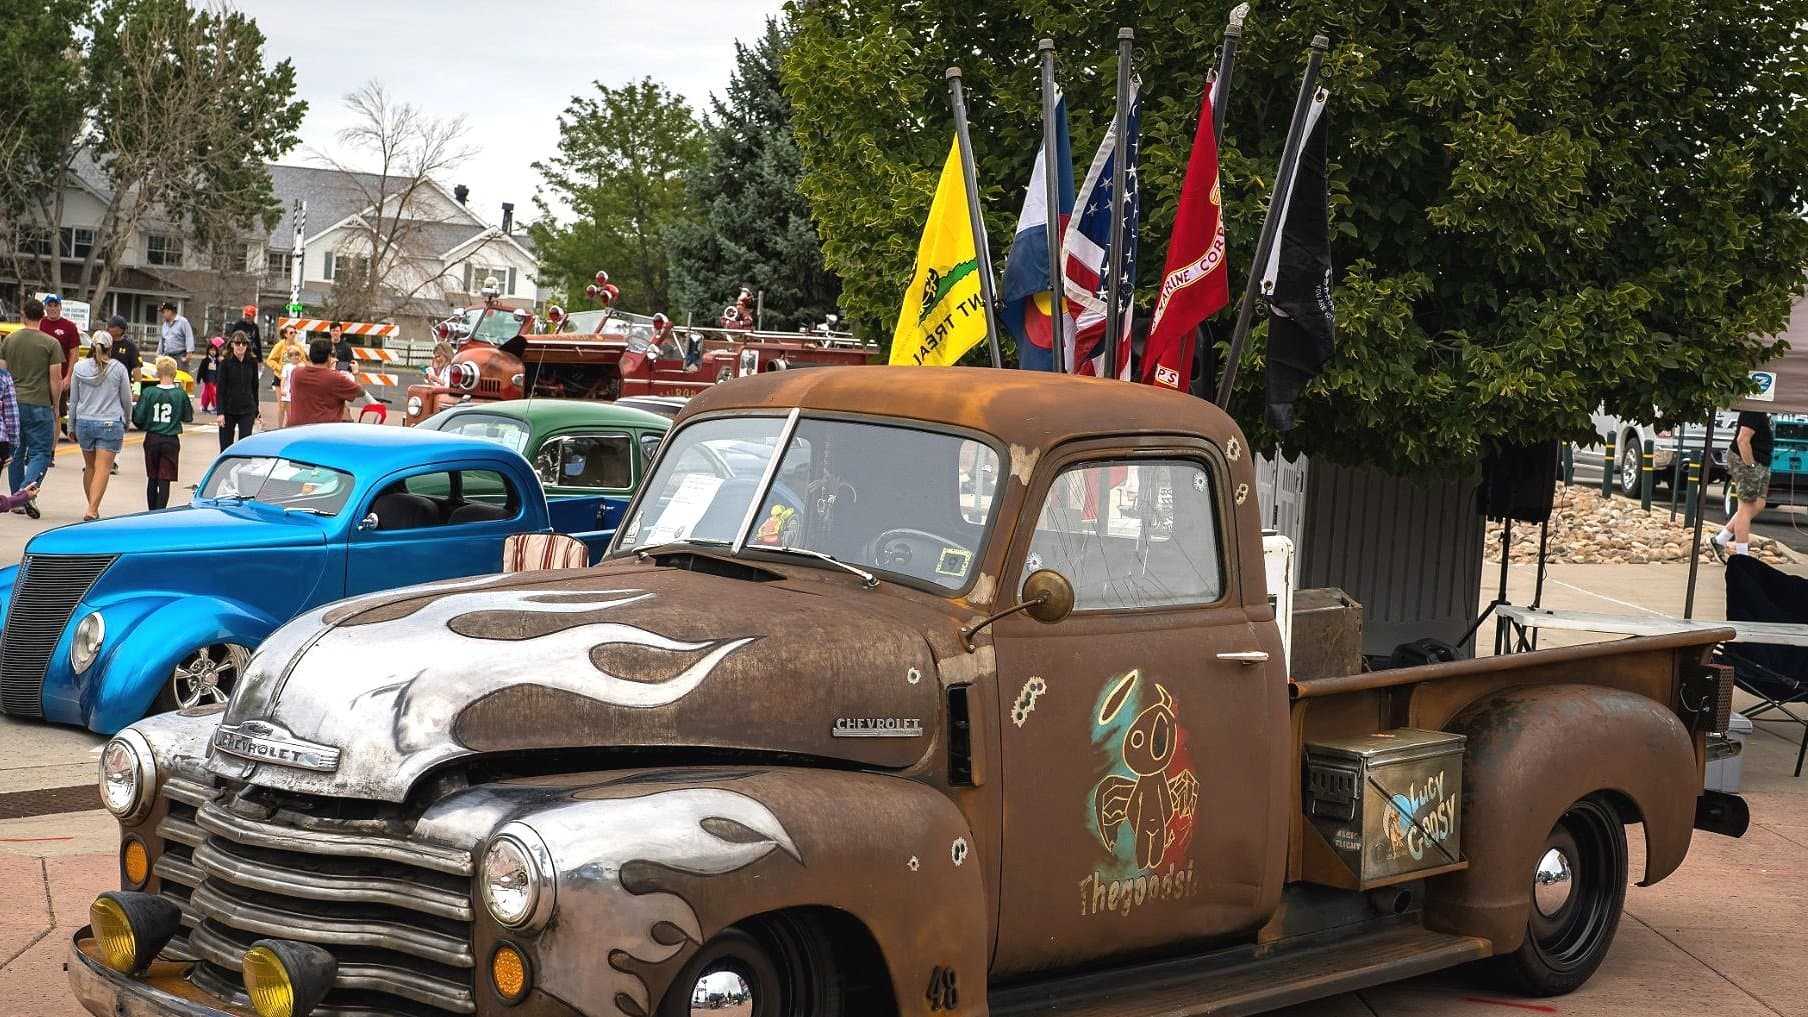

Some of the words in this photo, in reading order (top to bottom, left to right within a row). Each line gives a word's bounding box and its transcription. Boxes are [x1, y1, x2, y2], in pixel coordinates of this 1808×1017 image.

[1158, 269, 1191, 312] MARINE
[152, 402, 172, 423] 12
[836, 717, 921, 729] CHEVROLET
[221, 733, 303, 763] CHEVROLET
[925, 964, 957, 1012] 48
